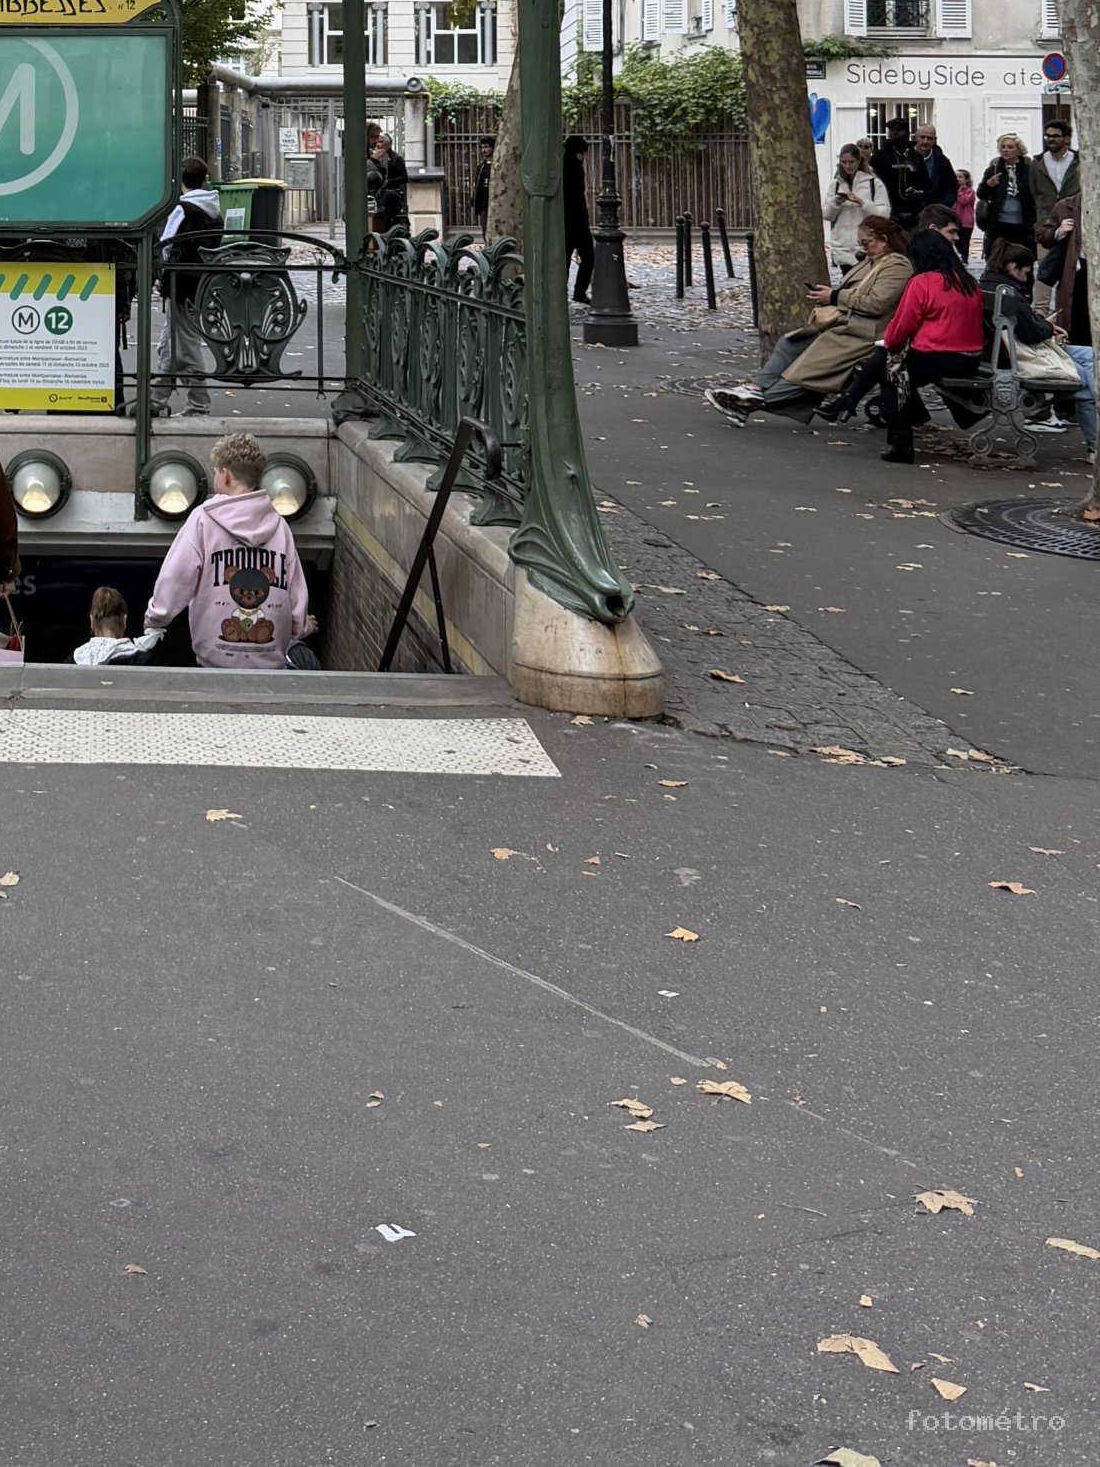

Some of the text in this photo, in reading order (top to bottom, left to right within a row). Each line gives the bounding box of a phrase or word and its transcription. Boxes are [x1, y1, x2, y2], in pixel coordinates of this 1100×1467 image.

[125, 0, 136, 10] 12
[846, 63, 1044, 91] SidebySide ate
[18, 312, 68, 328] M 12
